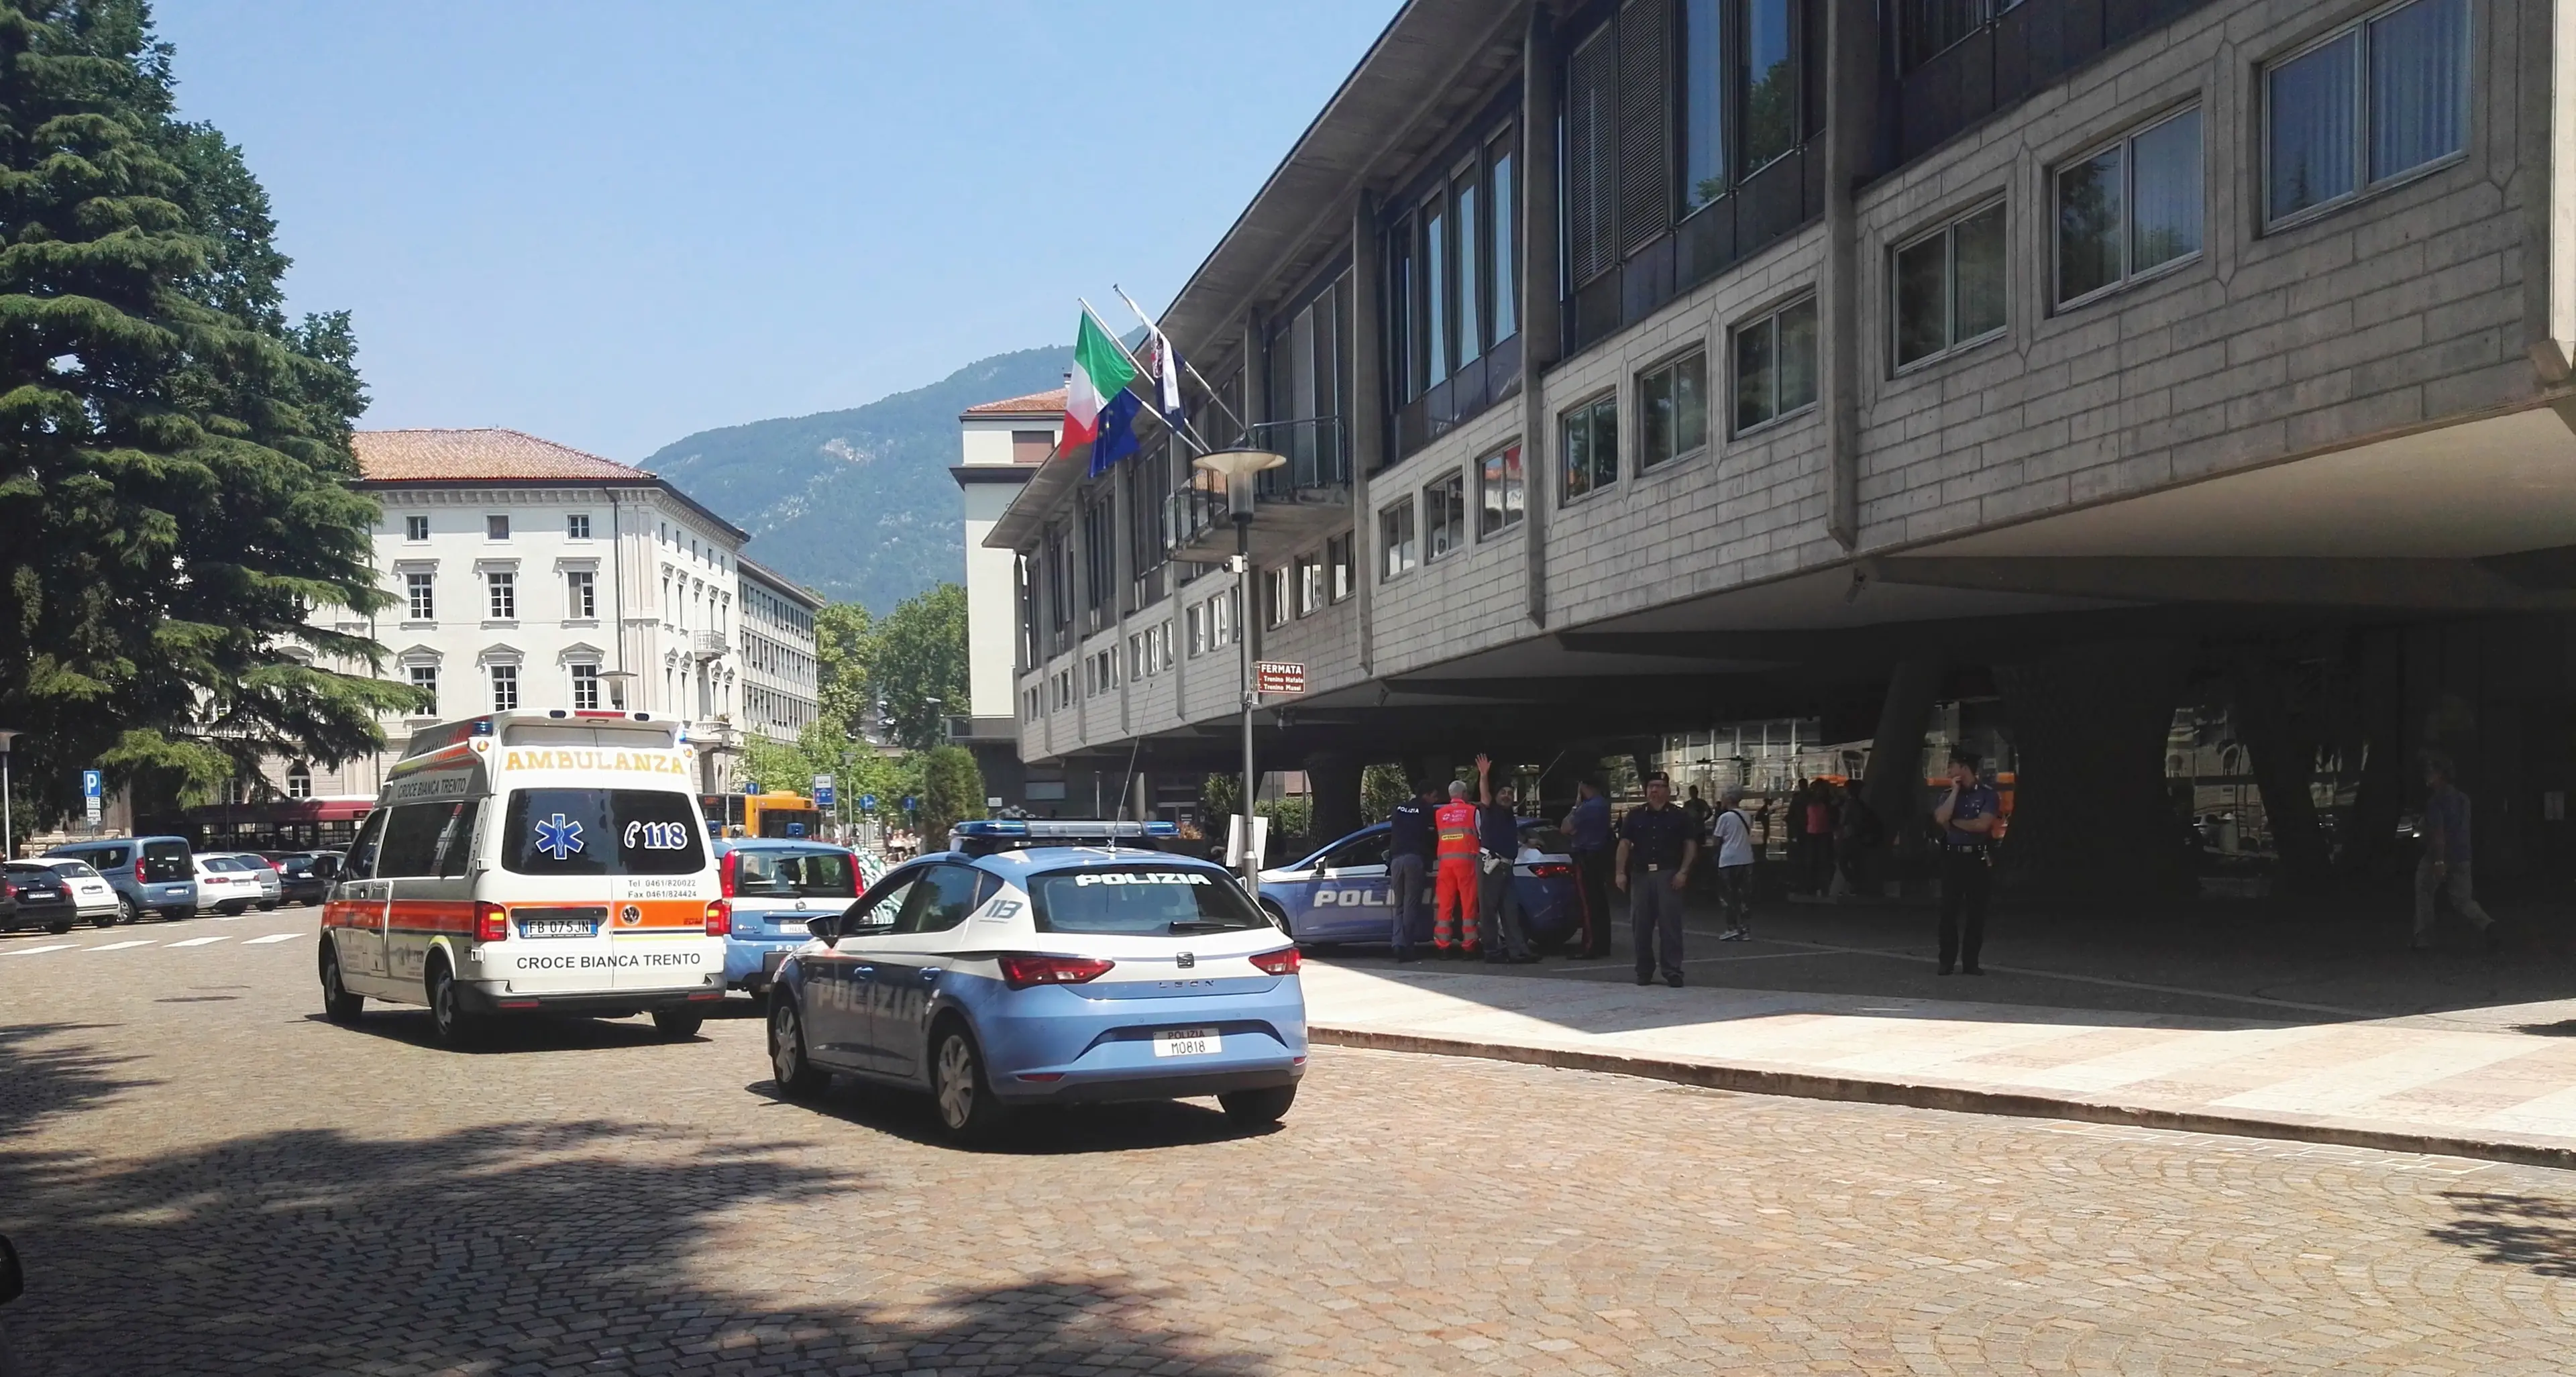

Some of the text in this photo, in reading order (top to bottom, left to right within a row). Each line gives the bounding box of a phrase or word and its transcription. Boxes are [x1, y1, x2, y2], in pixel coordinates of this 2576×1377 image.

[1261, 664, 1301, 674] FERMATA
[505, 751, 686, 775] AMBULANZA
[87, 773, 97, 794] P
[398, 777, 467, 798] CROCE BIANCA TRENTO
[1397, 806, 1419, 814] POLIZIA
[643, 822, 687, 848] 118
[1075, 873, 1212, 887] POLIZIA
[646, 890, 696, 898] 0461/824424
[985, 899, 1023, 919] 113
[529, 920, 589, 933] FB 075JN
[517, 953, 701, 969] CROCE BIANCA TRENTO
[1159, 980, 1214, 988] LEON
[818, 977, 924, 1023] POLIZIA
[1168, 1030, 1205, 1040] POLIZIA
